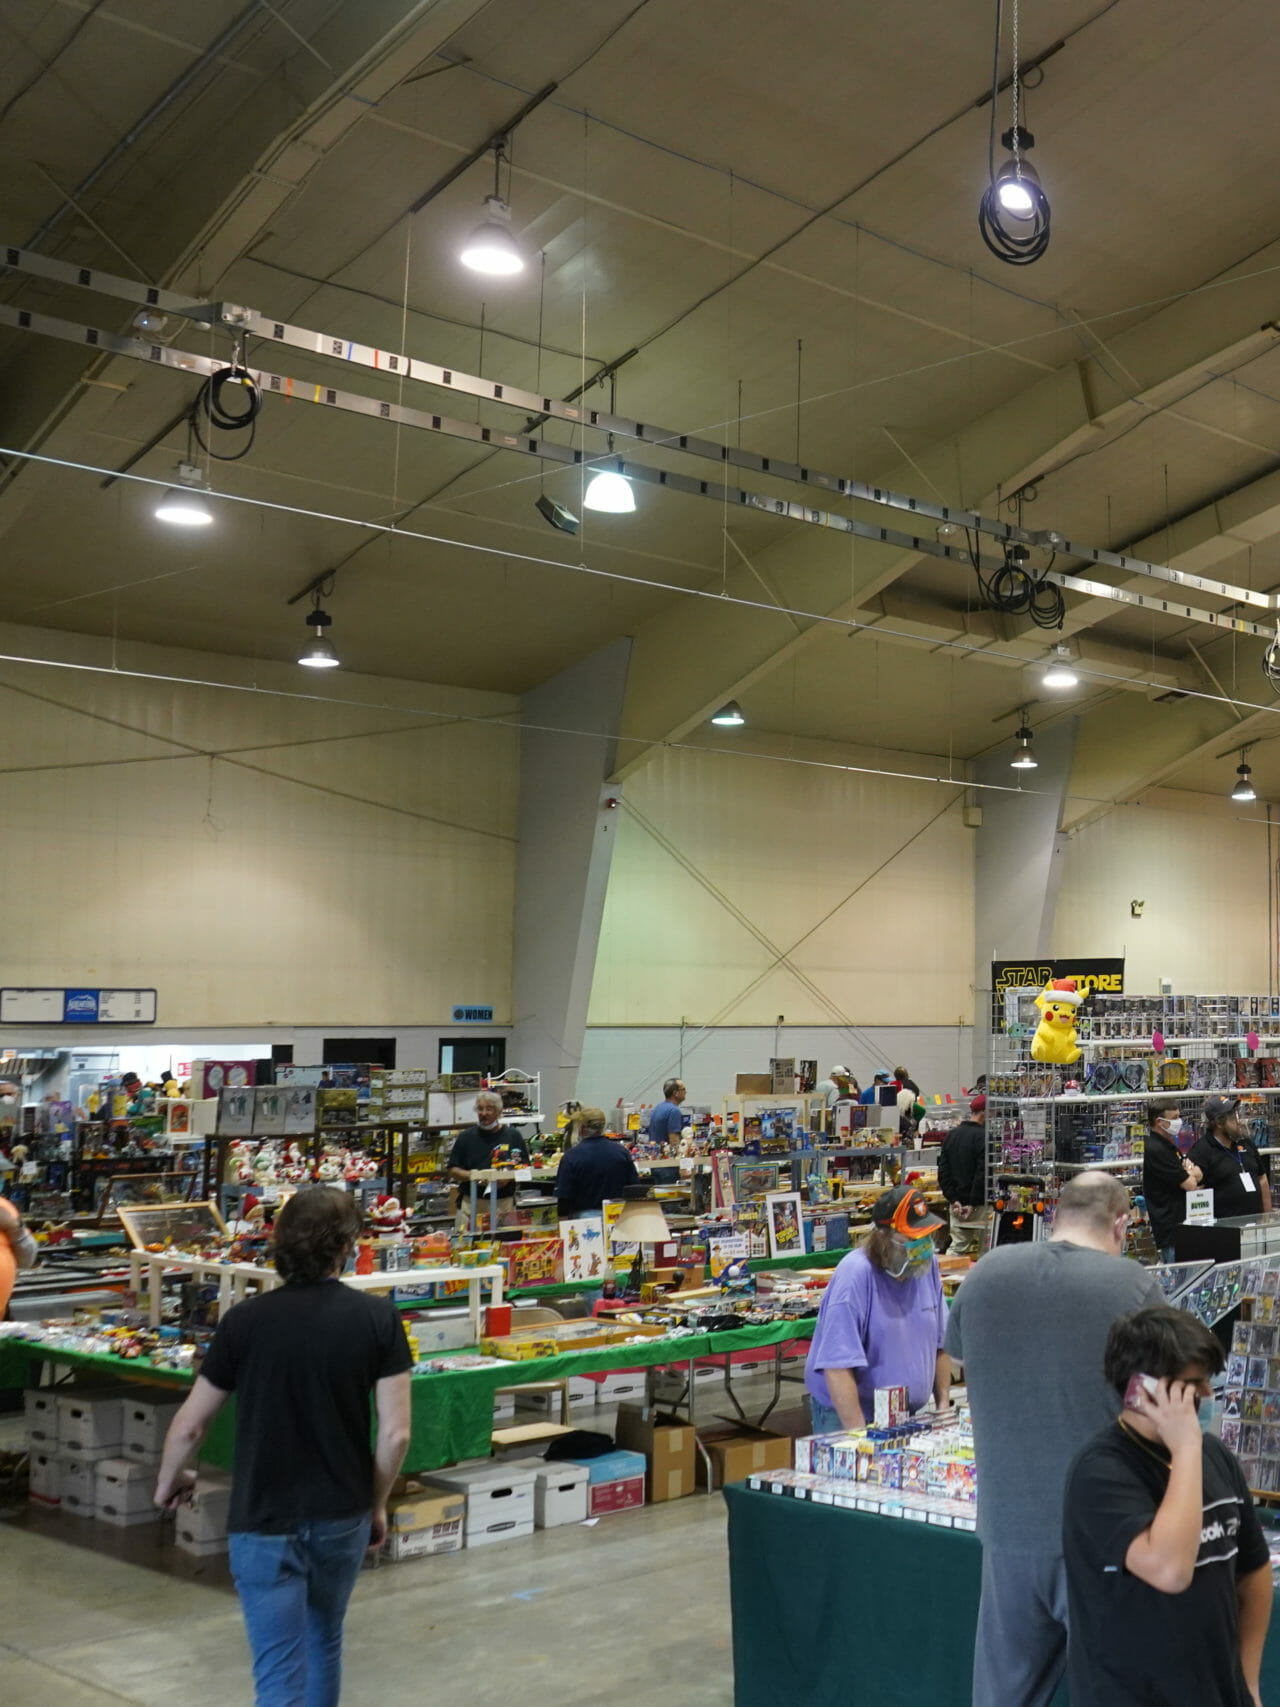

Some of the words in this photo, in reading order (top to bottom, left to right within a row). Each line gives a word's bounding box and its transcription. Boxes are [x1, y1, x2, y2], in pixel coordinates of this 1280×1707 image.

[996, 967, 1053, 987] STAR
[465, 1009, 493, 1020] WOMEN
[1191, 1201, 1209, 1210] BUYING
